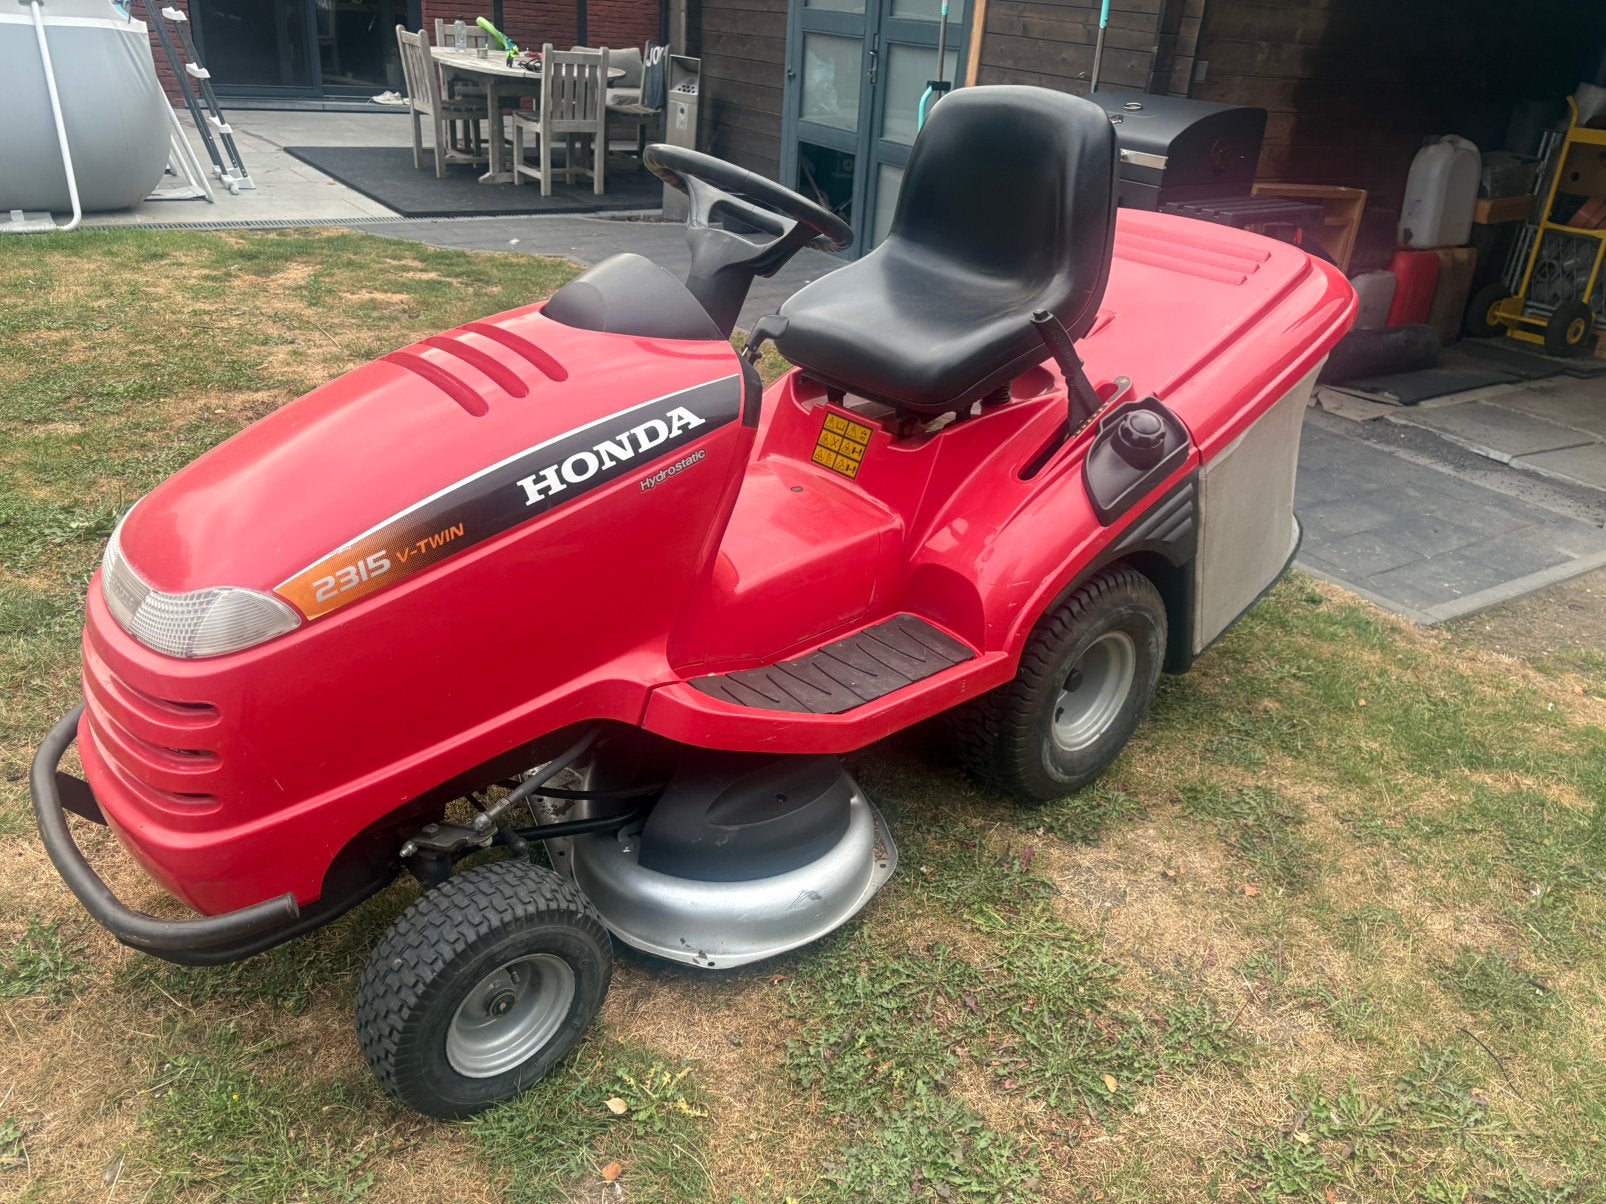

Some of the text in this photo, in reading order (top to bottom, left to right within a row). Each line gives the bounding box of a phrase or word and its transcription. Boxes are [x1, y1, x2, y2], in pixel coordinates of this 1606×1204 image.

[516, 406, 706, 506] HONDA
[640, 449, 706, 491] Hydrostatic
[311, 522, 465, 603] 2315 V-TWIN
